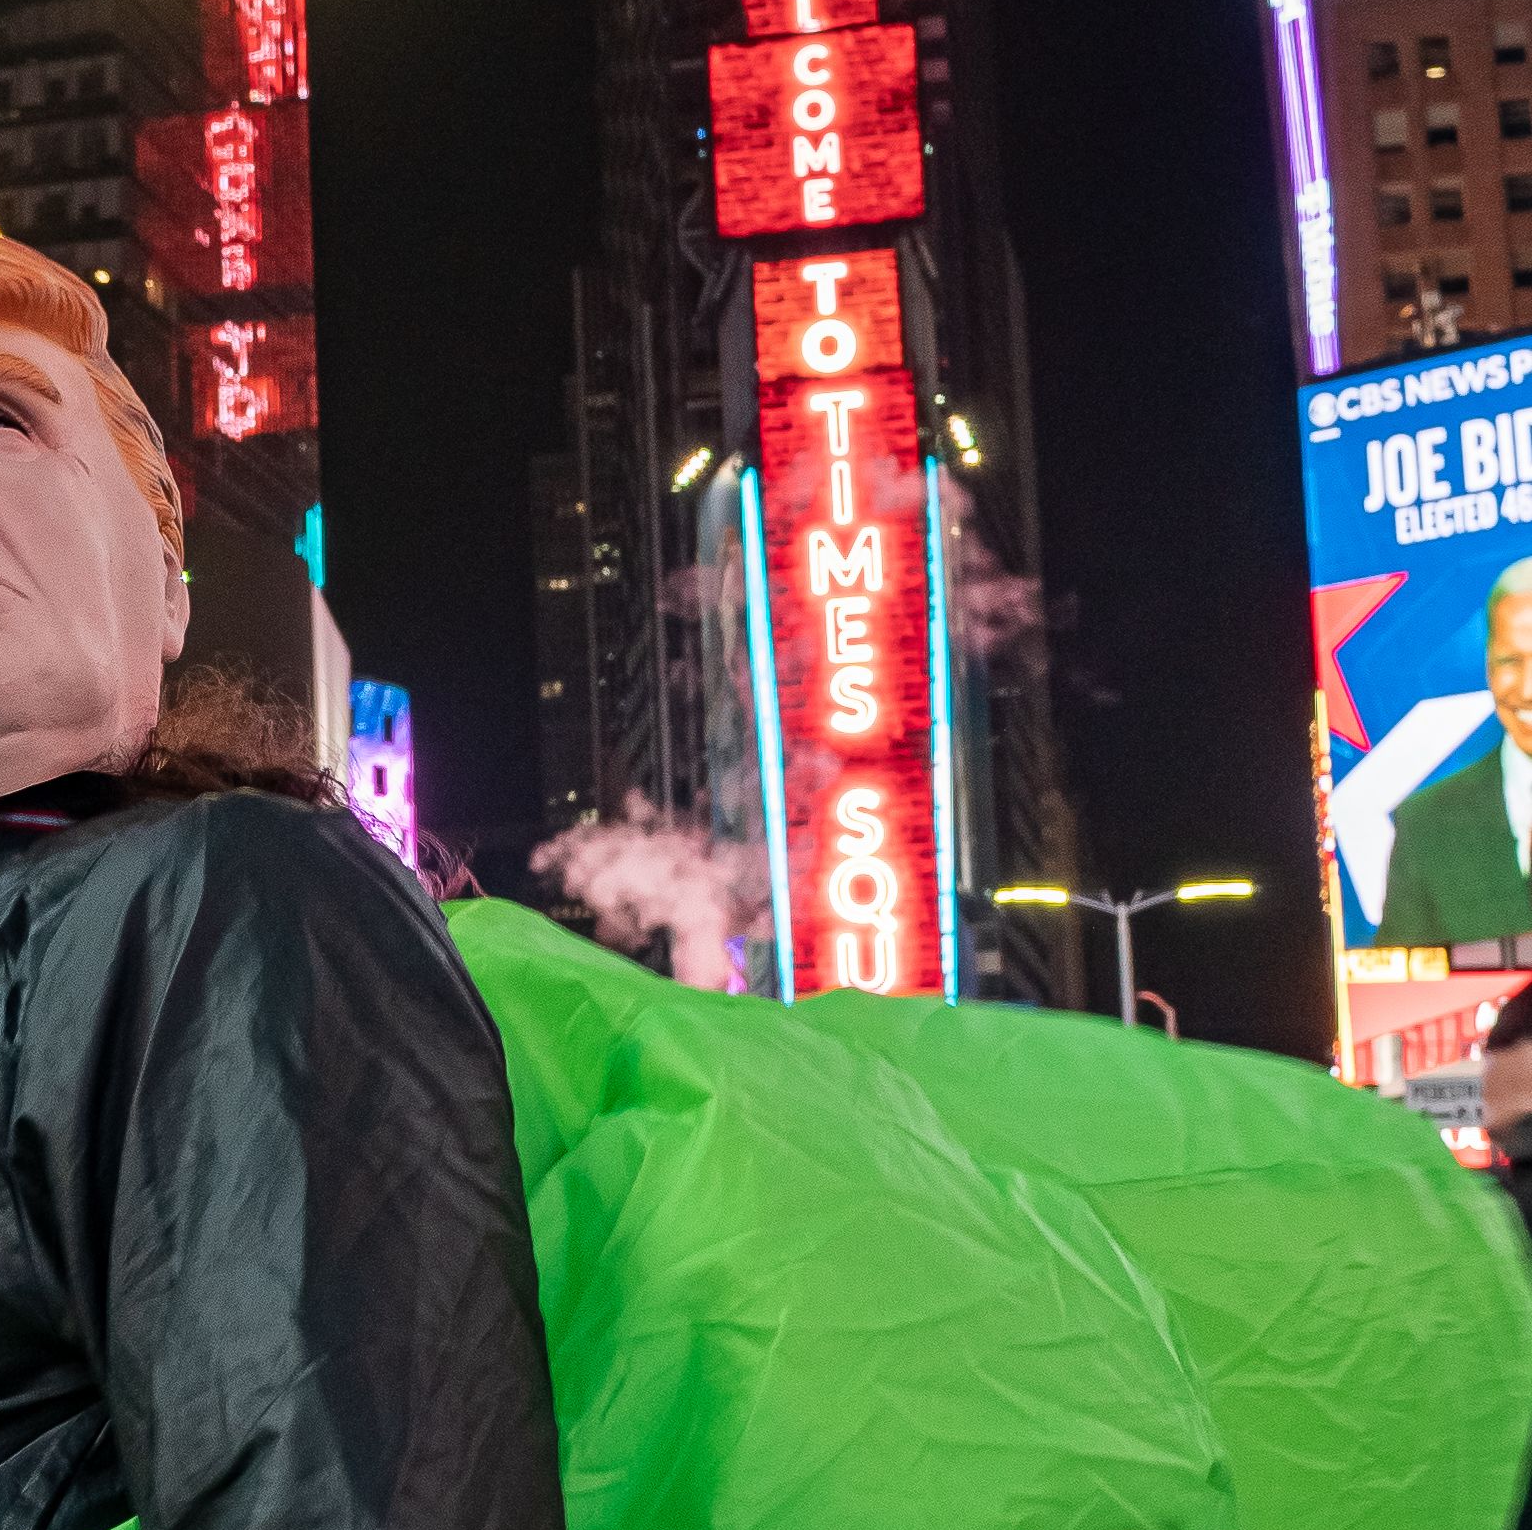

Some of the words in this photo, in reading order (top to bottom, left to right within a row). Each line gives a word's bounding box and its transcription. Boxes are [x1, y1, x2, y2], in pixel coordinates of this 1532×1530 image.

[800, 260, 858, 376] TO
[1336, 377, 1404, 422] CBS
[1403, 354, 1510, 408] NEWS
[1363, 425, 1453, 514] JOE
[1394, 489, 1499, 546] ELECTED
[807, 389, 884, 736] TIMES
